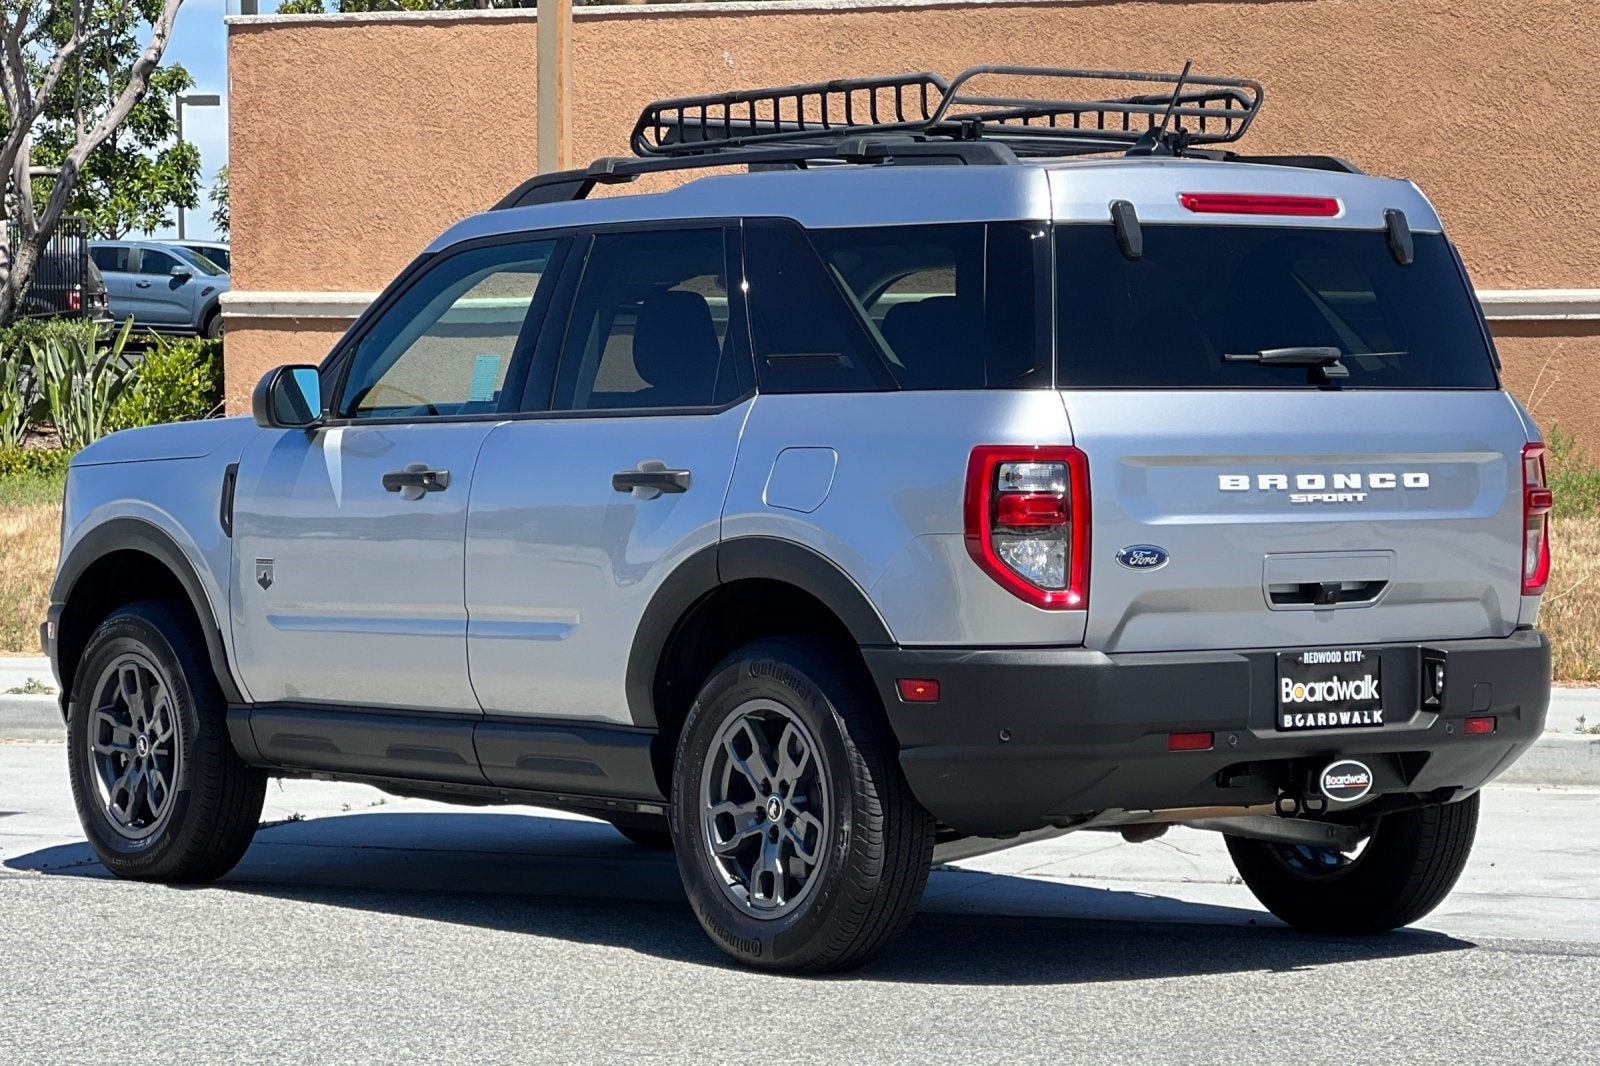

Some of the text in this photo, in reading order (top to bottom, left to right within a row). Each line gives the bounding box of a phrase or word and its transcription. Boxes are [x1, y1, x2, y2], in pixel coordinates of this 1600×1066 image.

[1218, 473, 1430, 491] BRONCO
[1289, 493, 1368, 503] SPORT
[1129, 550, 1159, 565] Ford
[1303, 650, 1362, 664] REDWOOD CITY
[749, 658, 812, 700] Continental
[1281, 674, 1380, 703] Boardwalk
[1283, 709, 1384, 728] BOARDWALK
[1325, 773, 1369, 786] Boardwalk
[704, 911, 763, 958] Continental
